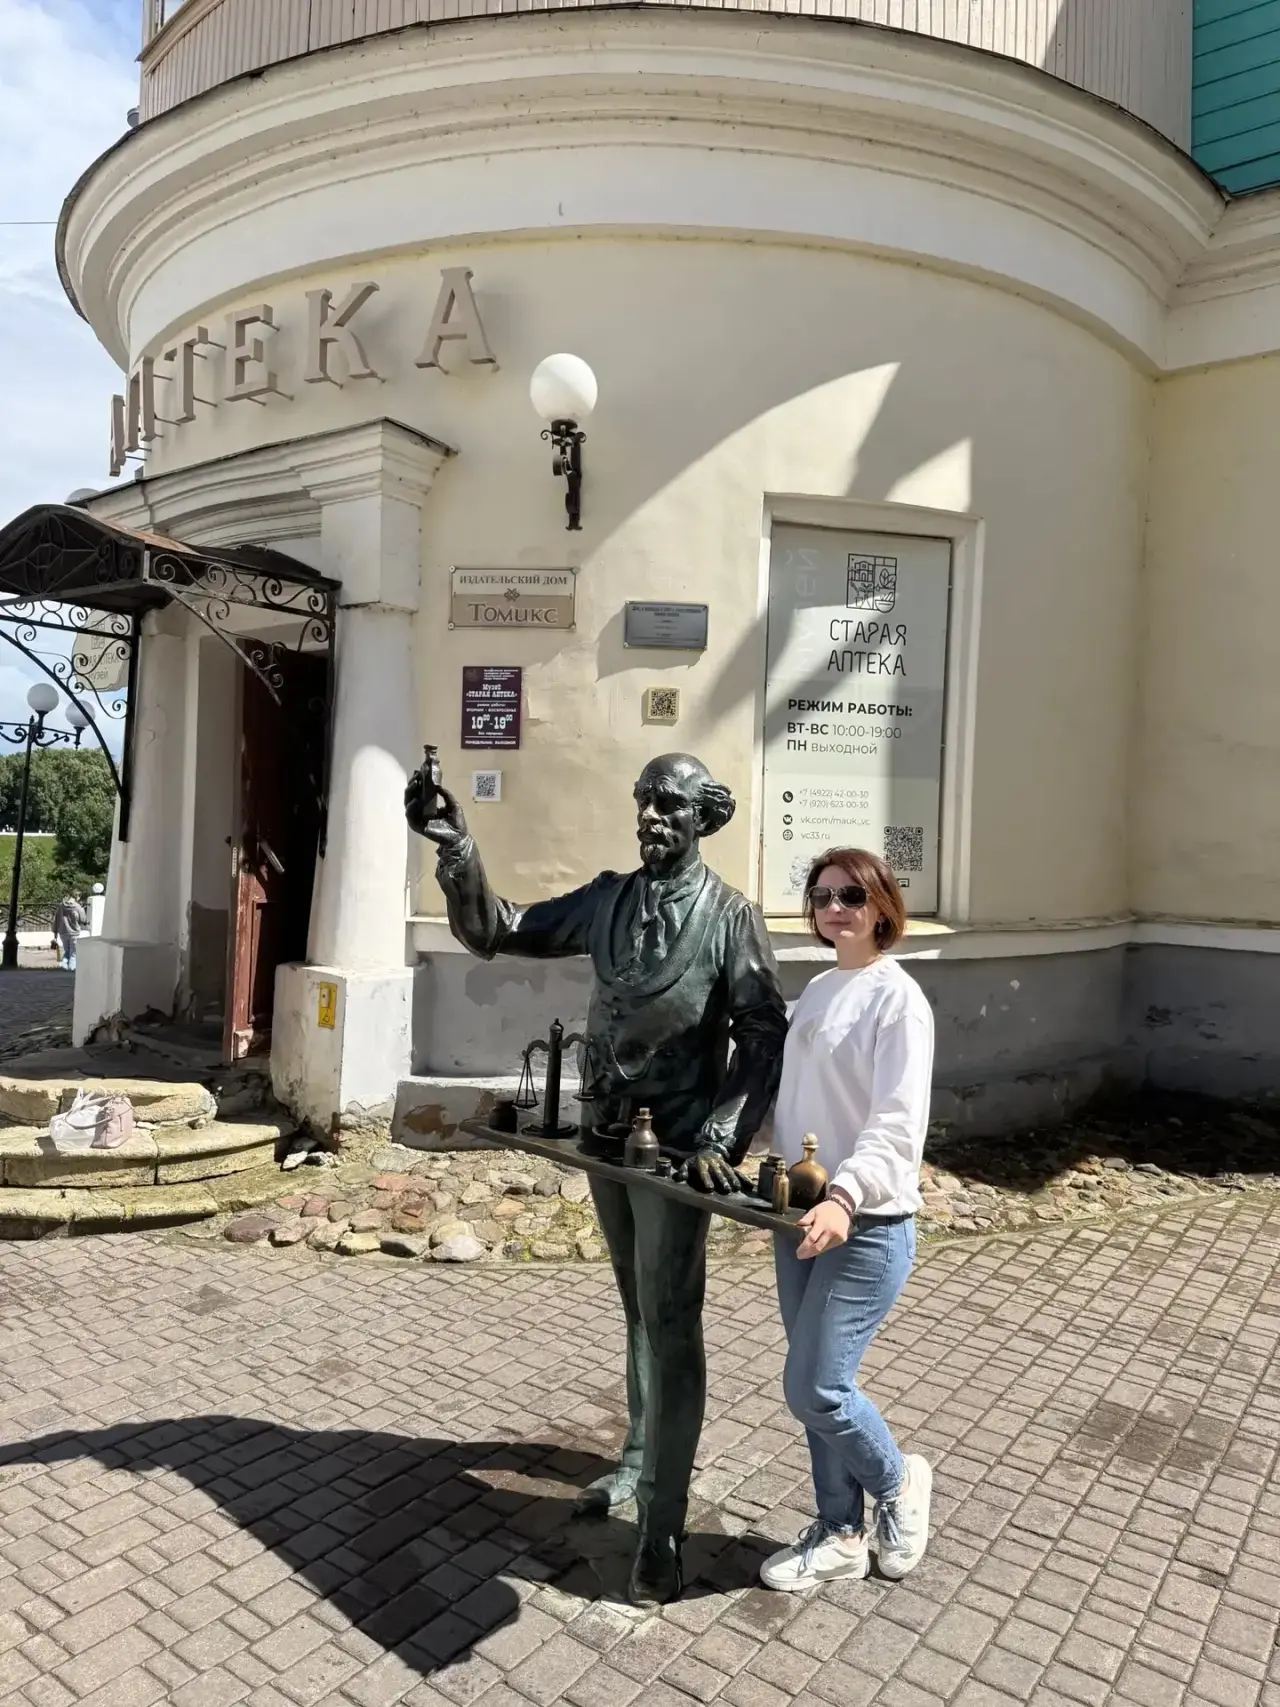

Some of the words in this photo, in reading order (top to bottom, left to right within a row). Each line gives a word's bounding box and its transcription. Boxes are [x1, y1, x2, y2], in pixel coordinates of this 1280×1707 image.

[459, 574, 540, 585] ИЗДАТЕЛЬСКИЙ
[542, 576, 567, 585] ДОМ
[829, 619, 907, 646] СТАРАЯ
[827, 650, 907, 676] АПТЕКА
[482, 683, 502, 691] Музей
[788, 699, 843, 713] РЕЖИМ
[848, 702, 913, 717] РАБОТЫ:
[787, 722, 829, 735] ВТ-ВС
[832, 724, 902, 739] 10:00-19:00
[787, 739, 807, 751] ПН
